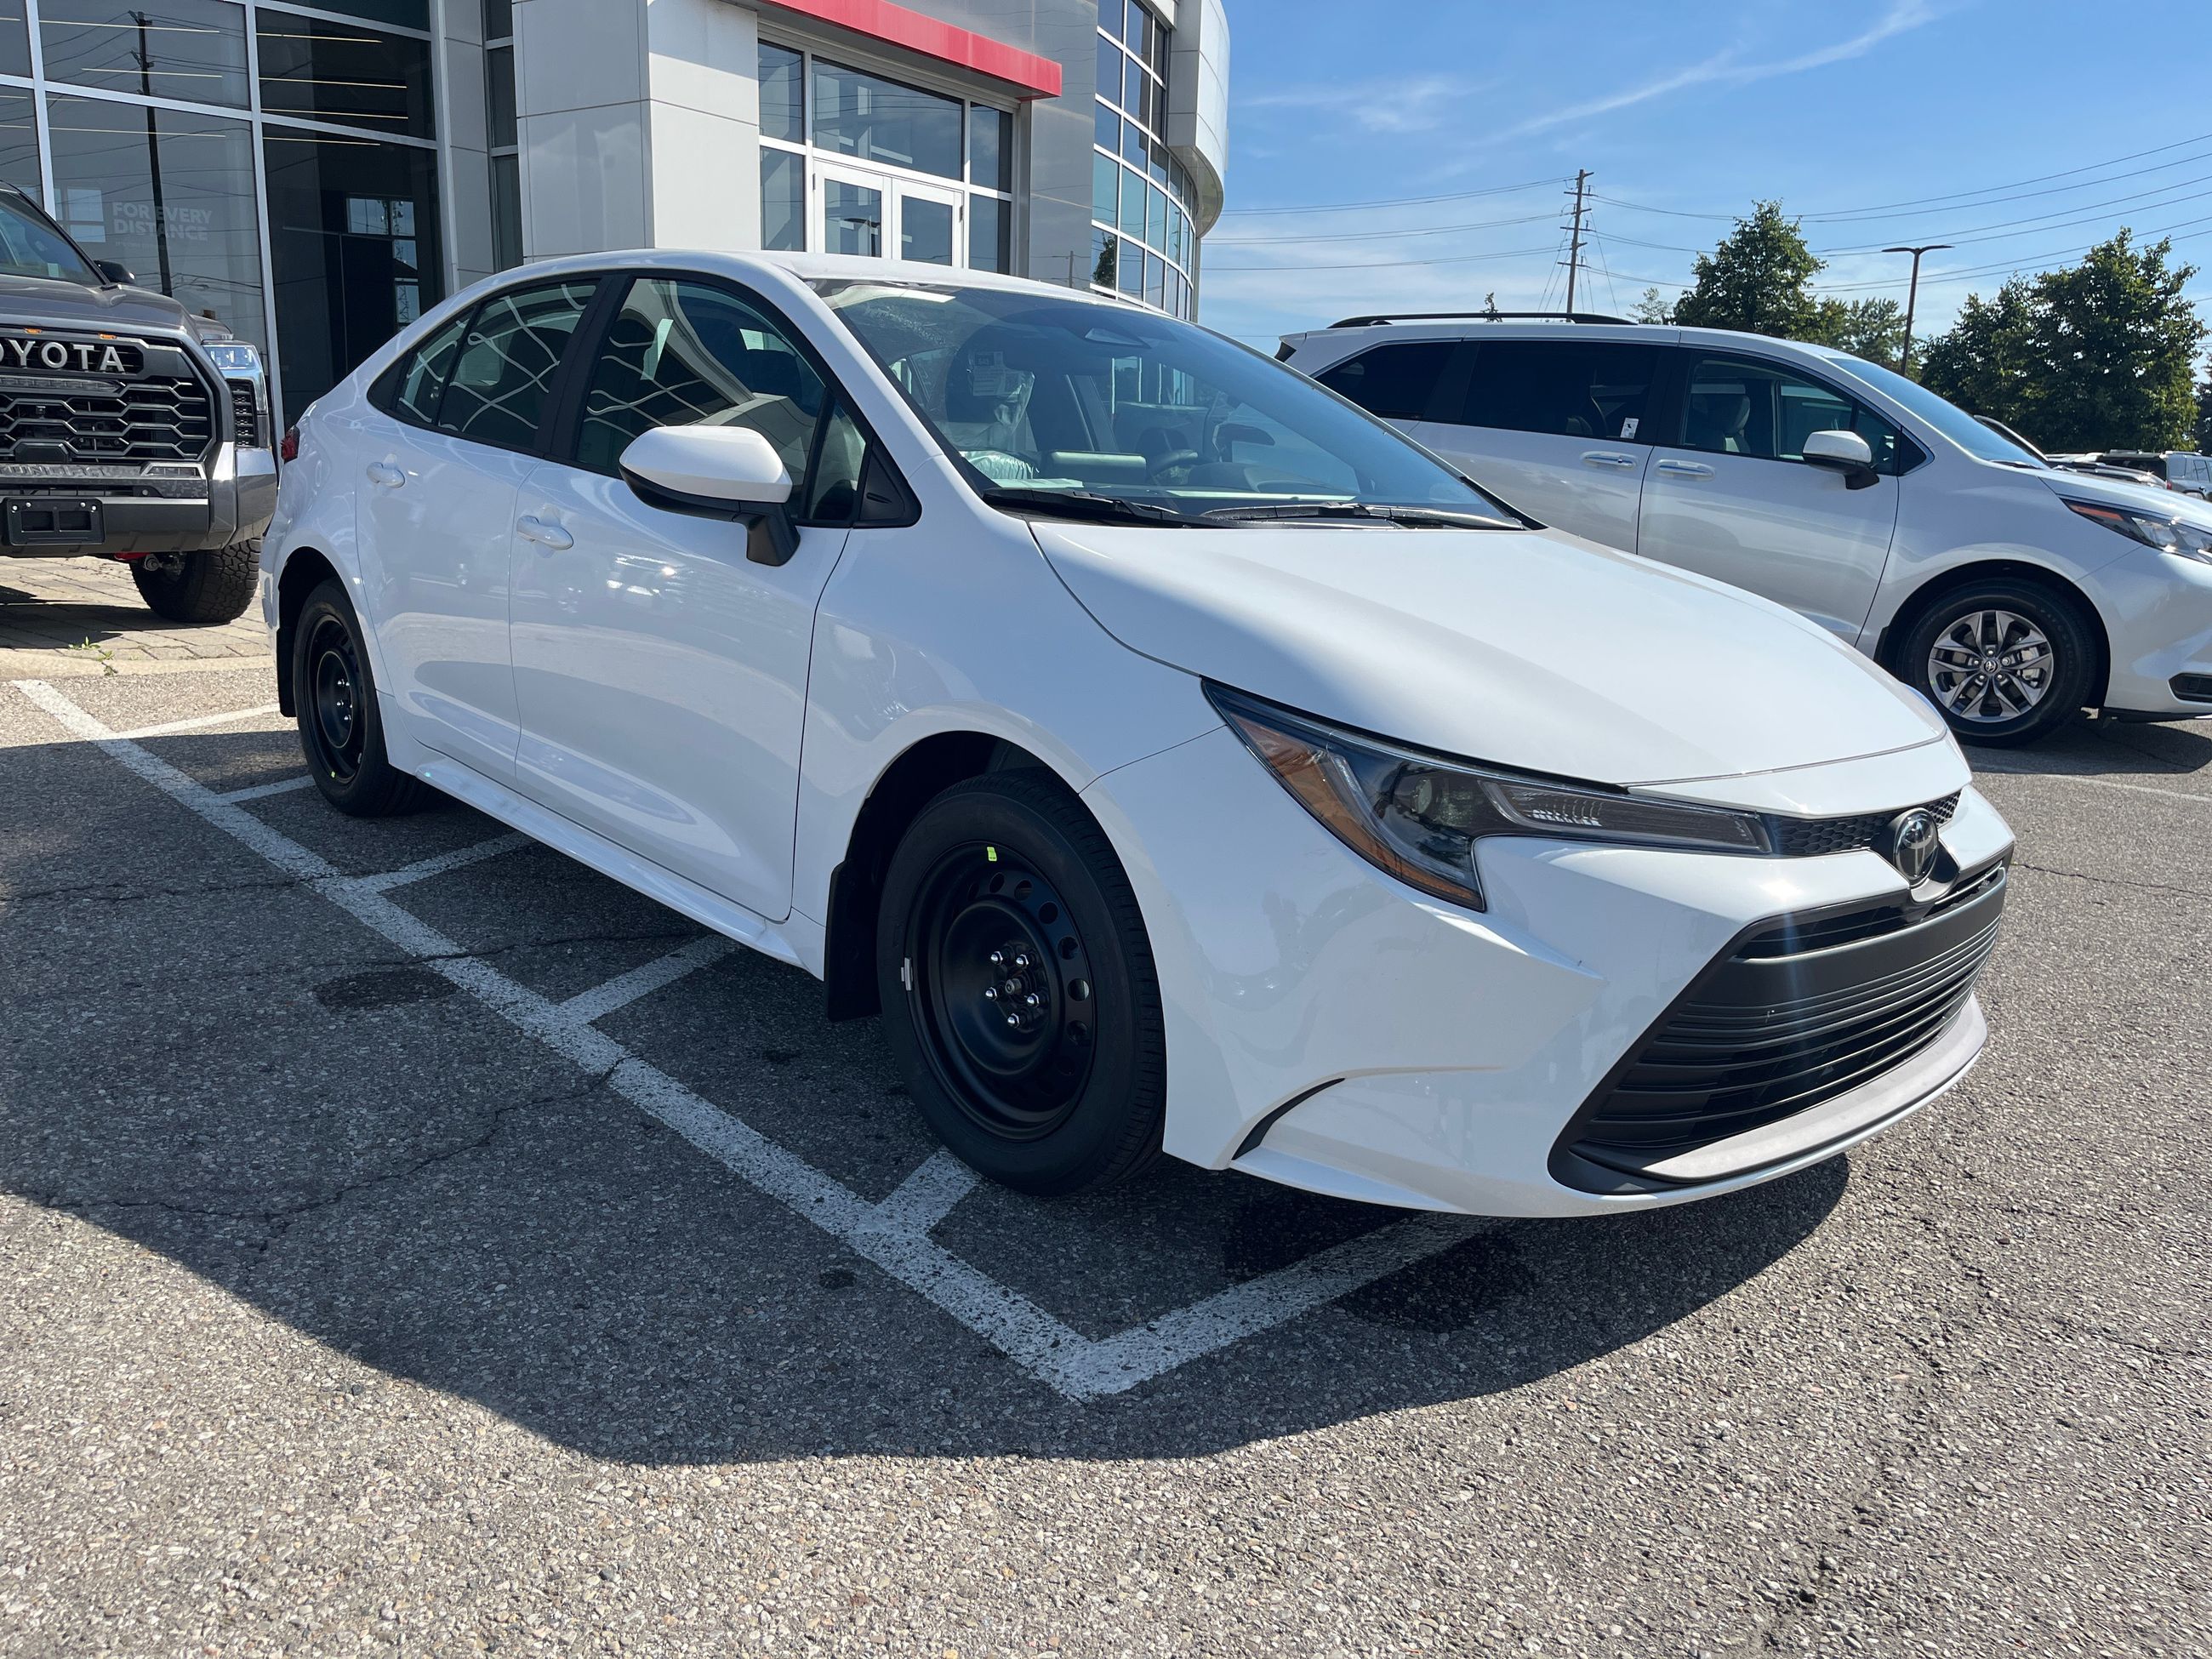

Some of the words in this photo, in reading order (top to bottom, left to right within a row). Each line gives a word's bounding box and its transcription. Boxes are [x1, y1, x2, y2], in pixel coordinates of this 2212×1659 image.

[113, 202, 150, 218] FOR
[155, 206, 213, 225] EVERY
[114, 219, 208, 242] DISTANCE
[0, 339, 126, 373] YOTA
